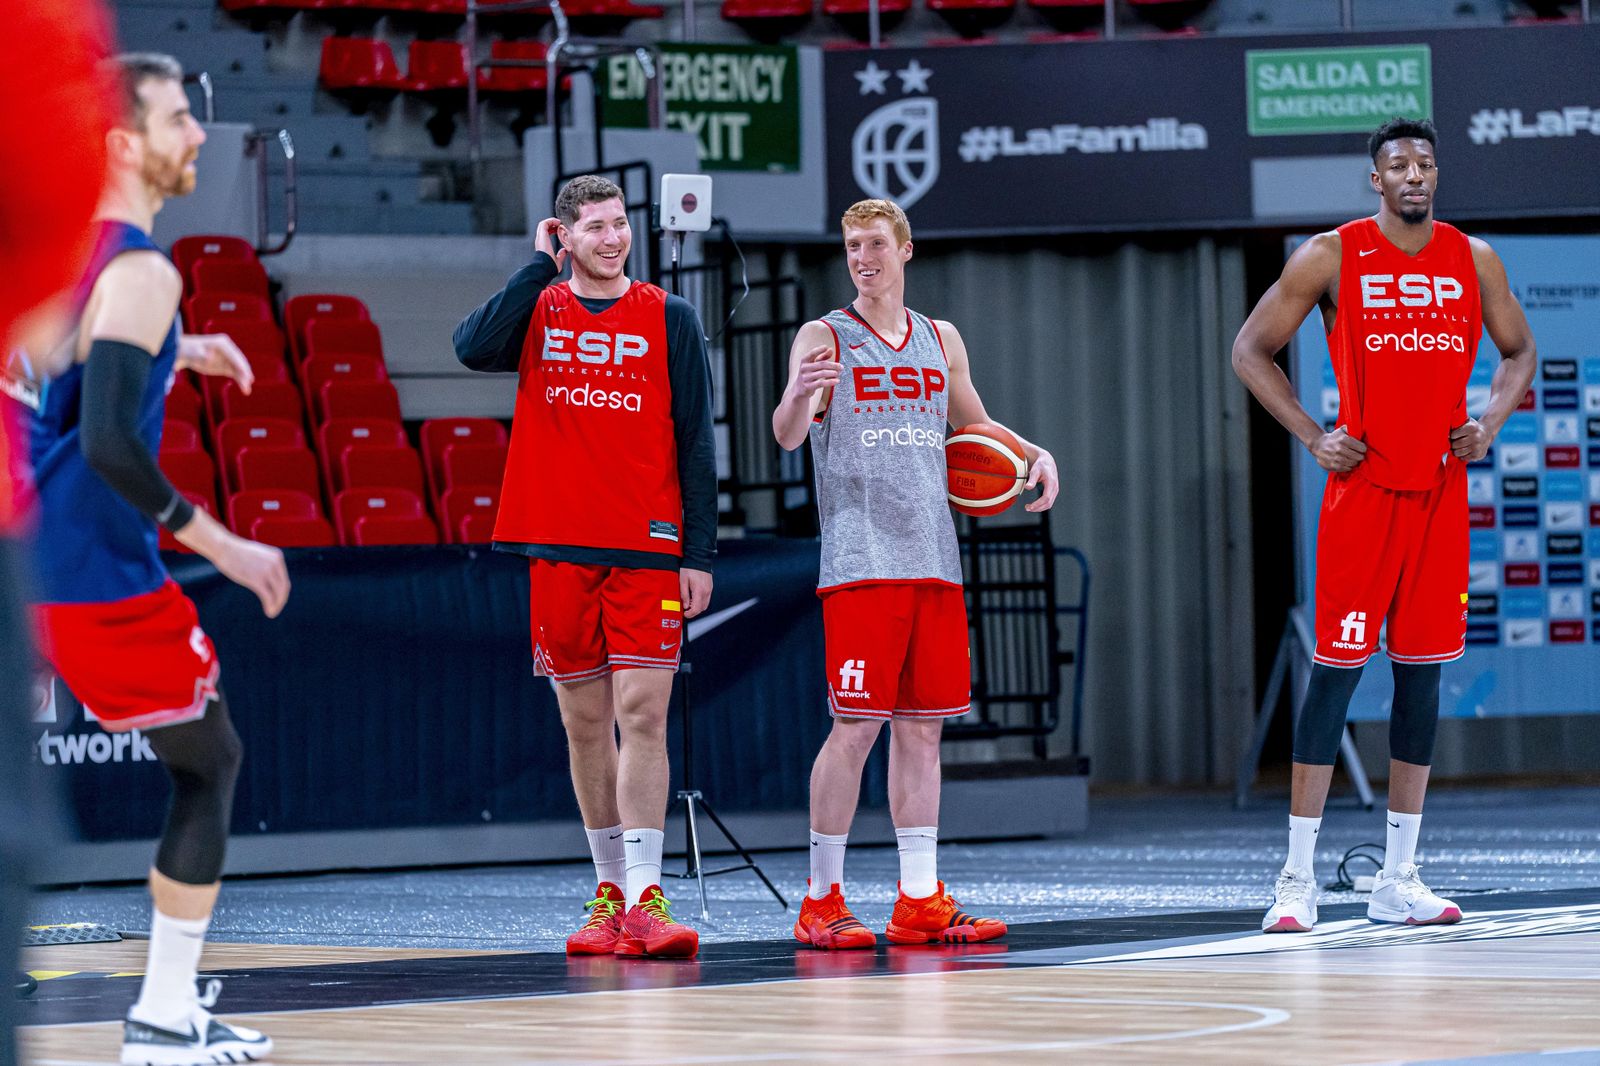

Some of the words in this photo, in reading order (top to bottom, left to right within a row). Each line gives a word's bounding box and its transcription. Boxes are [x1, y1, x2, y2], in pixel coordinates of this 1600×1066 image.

[608, 53, 787, 103] EMERGENCY
[1257, 60, 1370, 91] SALIDA
[1377, 59, 1421, 86] DE
[1259, 92, 1422, 119] EMERGENCIA
[666, 112, 750, 161] XIT
[958, 117, 1208, 162] #LaFamilia
[670, 216, 676, 225] 2
[1360, 273, 1463, 308] ESP
[541, 326, 649, 365] ESP
[1365, 327, 1464, 352] endesa
[541, 366, 647, 381] ASKETBALL
[852, 366, 945, 401] ESP
[546, 382, 641, 412] endesa
[861, 422, 943, 450] endesa
[956, 476, 976, 488] FIBA
[661, 618, 680, 629] ESP
[1340, 611, 1366, 642] fi
[839, 659, 865, 690] fi
[37, 728, 157, 765] twork
